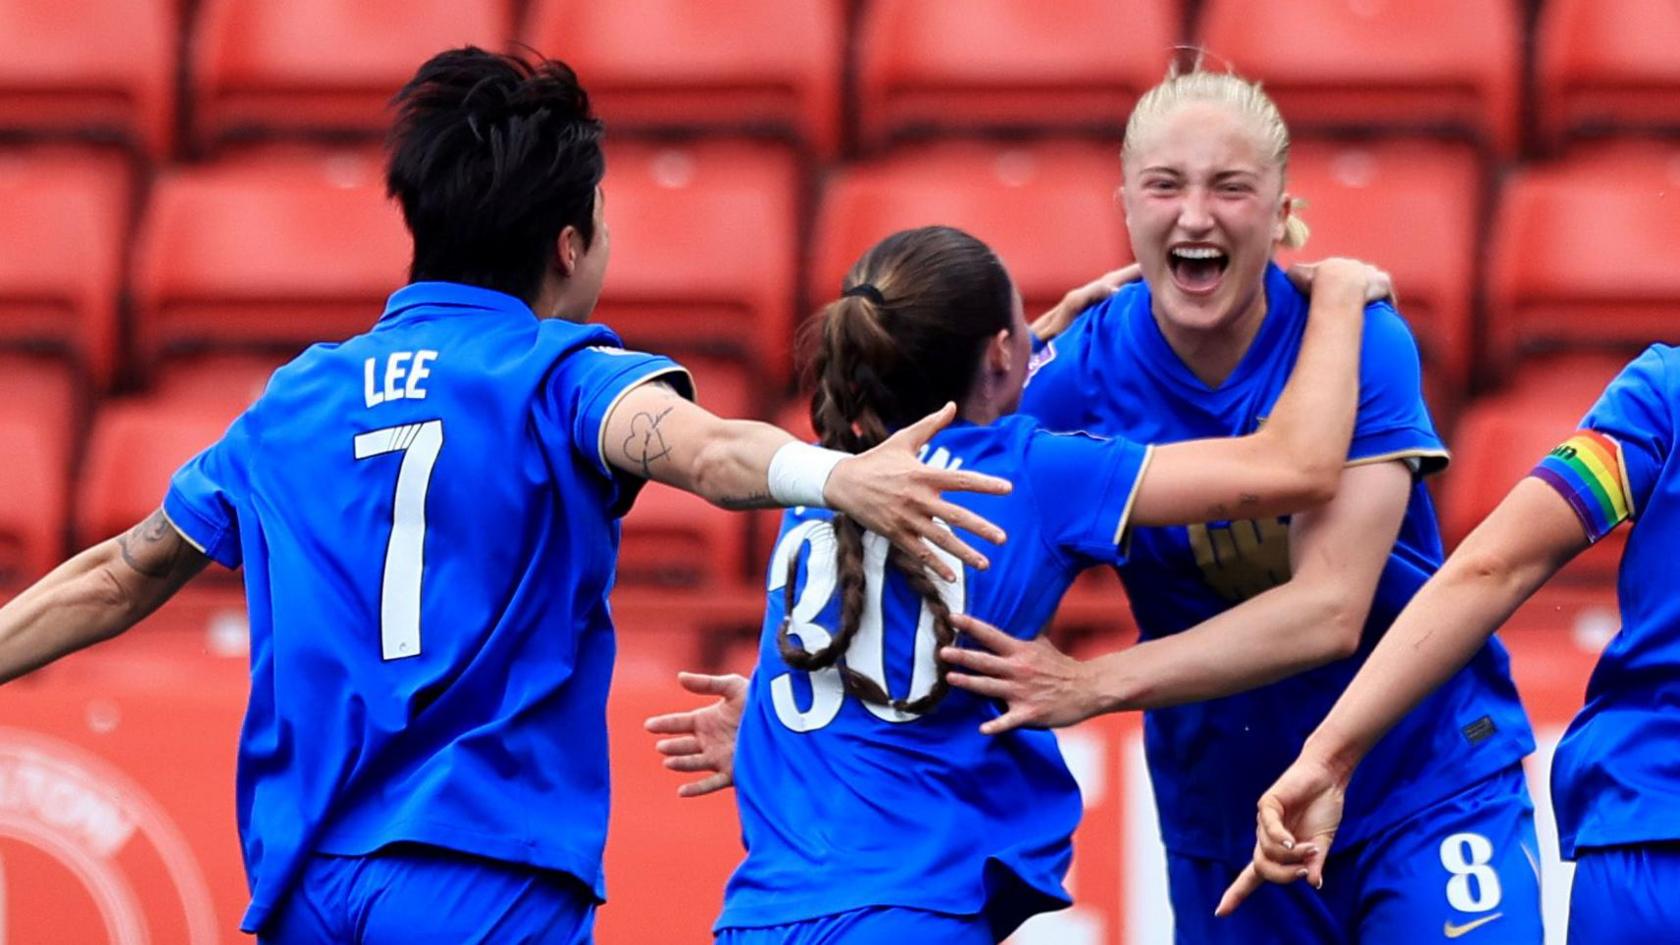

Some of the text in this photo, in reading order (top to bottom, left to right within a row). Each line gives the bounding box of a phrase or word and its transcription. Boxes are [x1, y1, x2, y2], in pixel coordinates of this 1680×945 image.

[364, 349, 438, 408] LEE
[353, 419, 444, 661] 7
[768, 518, 966, 733] 30
[1439, 832, 1502, 913] 8
